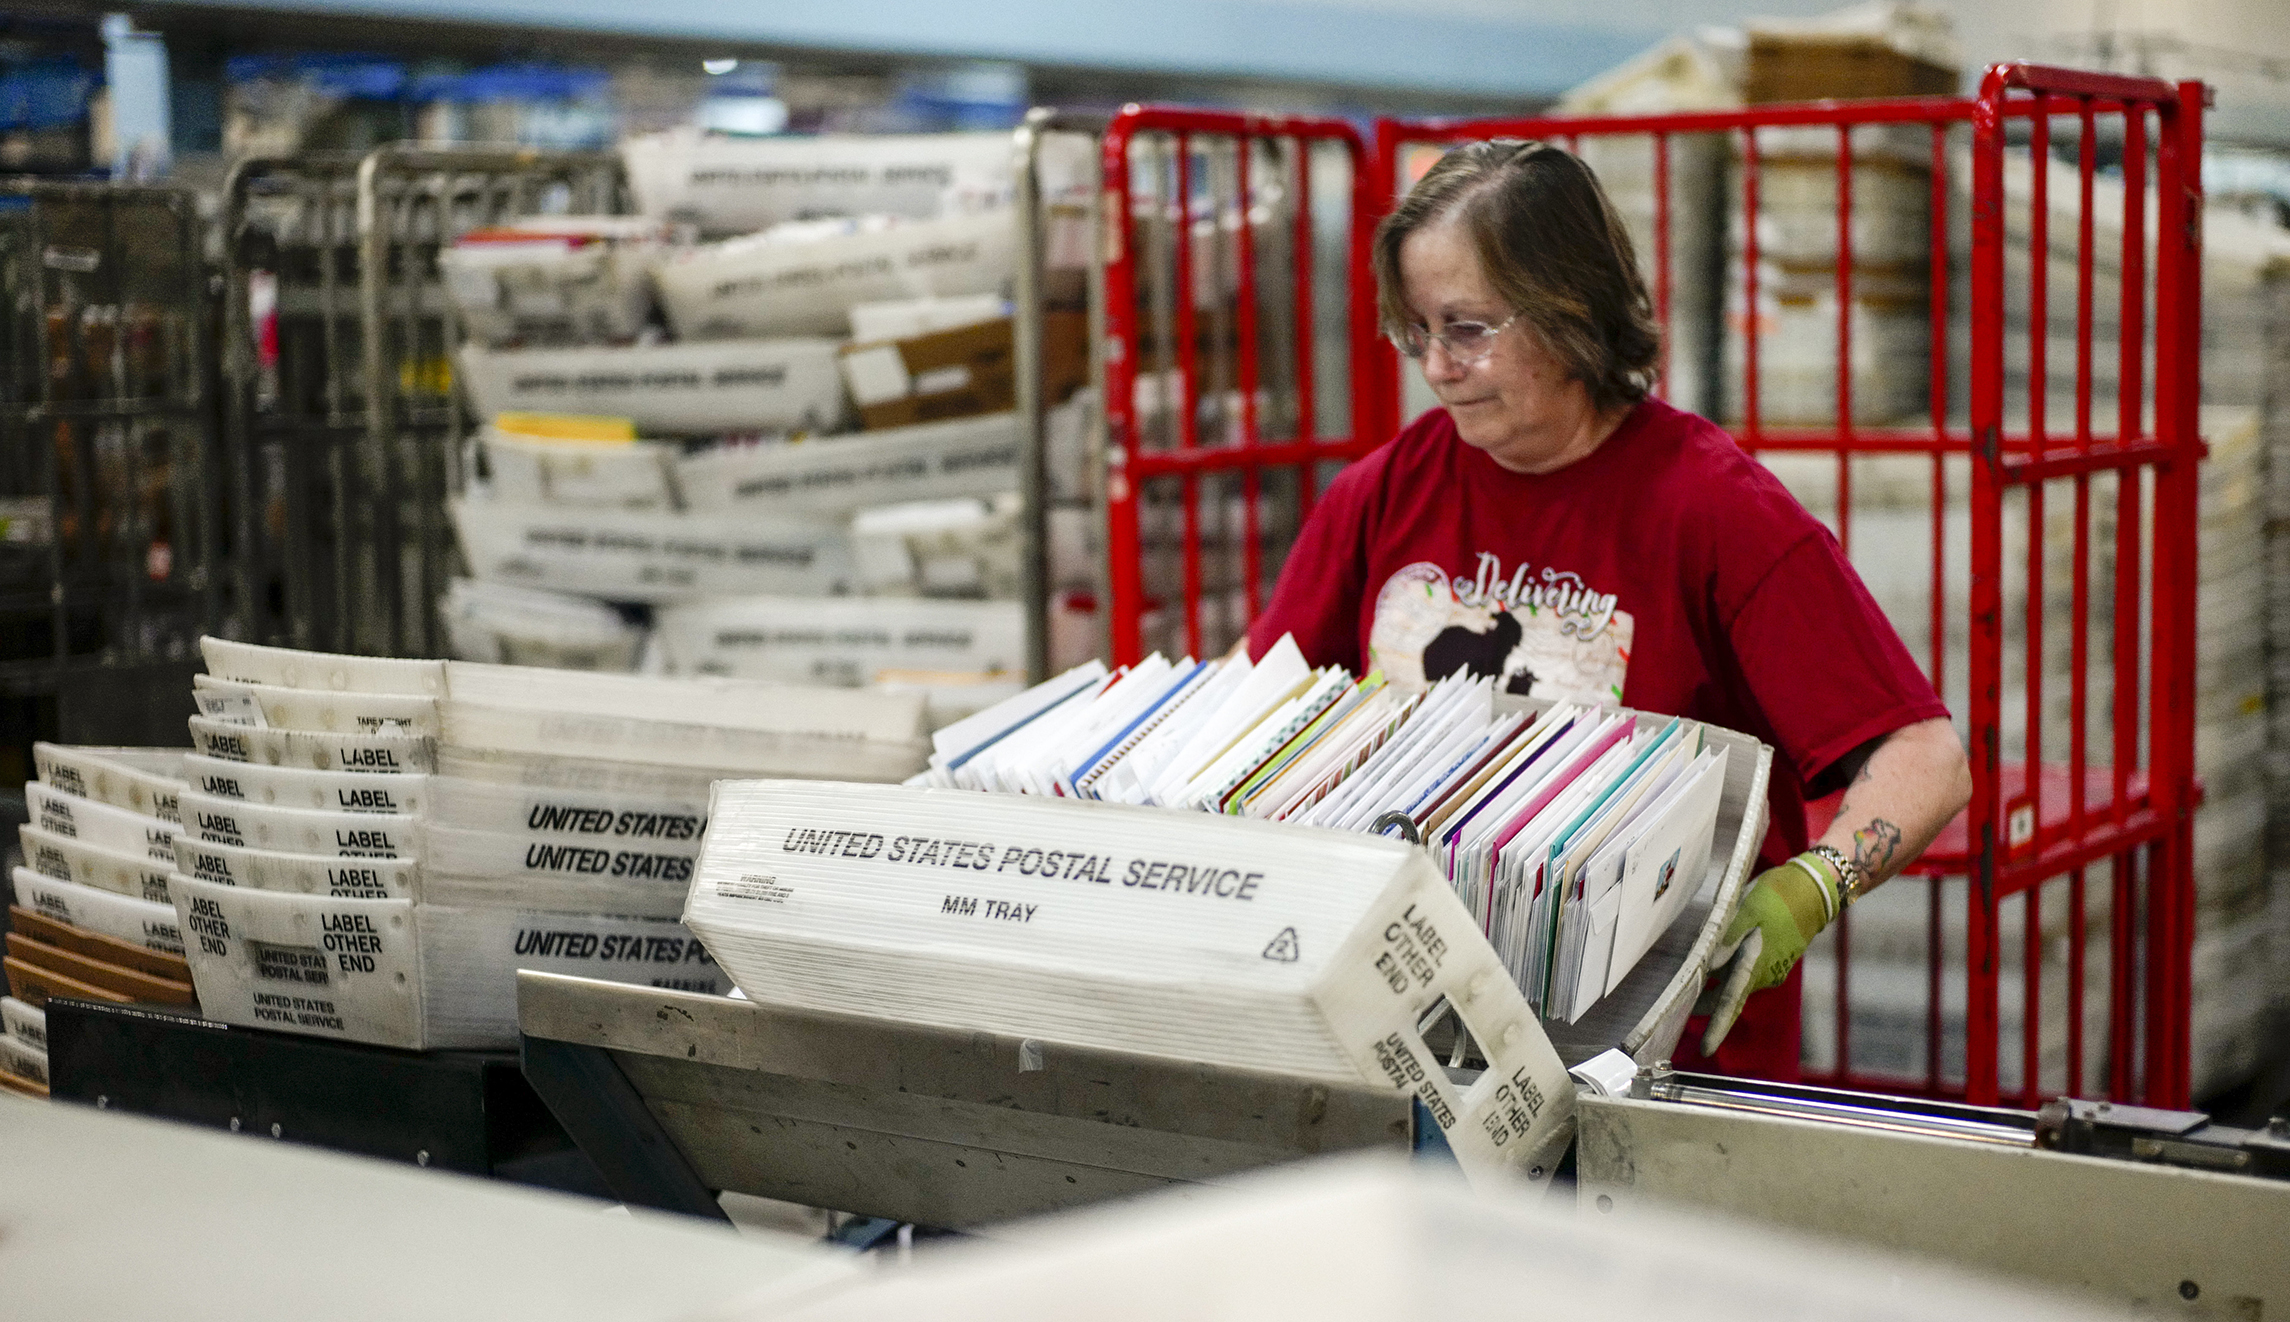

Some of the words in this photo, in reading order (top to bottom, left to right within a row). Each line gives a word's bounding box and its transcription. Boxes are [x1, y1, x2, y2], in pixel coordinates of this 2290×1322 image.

[1453, 551, 1618, 651] Delivering
[341, 749, 399, 767] LABEL
[48, 762, 84, 784] LABEL
[202, 776, 244, 798] LABEL
[339, 789, 397, 808] LABEL
[40, 797, 74, 822] LABEL
[41, 816, 77, 838] OTHER
[198, 812, 241, 836] LABEL
[528, 804, 614, 835] UNITED
[614, 811, 698, 840] STATES
[336, 830, 395, 849] LABEL
[195, 855, 232, 876] LABEL
[526, 844, 610, 874] UNITED
[611, 852, 694, 881] STATES
[783, 828, 884, 858] UNITED
[887, 835, 995, 871] STATES
[997, 846, 1112, 884] POSTAL
[1122, 859, 1264, 901] SERVICE
[328, 869, 384, 888] LABEL
[32, 889, 70, 913] LABEL
[941, 895, 978, 916] MM
[985, 900, 1038, 923] TRAY
[189, 914, 231, 940] OTHER
[322, 914, 377, 933] LABEL
[200, 936, 227, 957] END
[323, 934, 383, 953] OTHER
[515, 929, 599, 959] UNITED
[600, 935, 684, 963] STATES
[1403, 904, 1449, 968] LABEL
[260, 949, 298, 966] UNITED
[338, 954, 375, 973] END
[1384, 922, 1435, 988] OTHER
[261, 964, 302, 982] POSTAL
[1374, 951, 1409, 995] END
[253, 993, 291, 1008] UNITED
[293, 998, 335, 1014] STATES
[254, 1008, 296, 1024] POSTAL
[299, 1012, 345, 1030] SERVICE
[1386, 1032, 1425, 1084] UNITED
[1418, 1080, 1457, 1130] STATES
[1512, 1065, 1545, 1118] LABEL
[1495, 1083, 1531, 1139] OTHER
[1482, 1110, 1510, 1147] END
